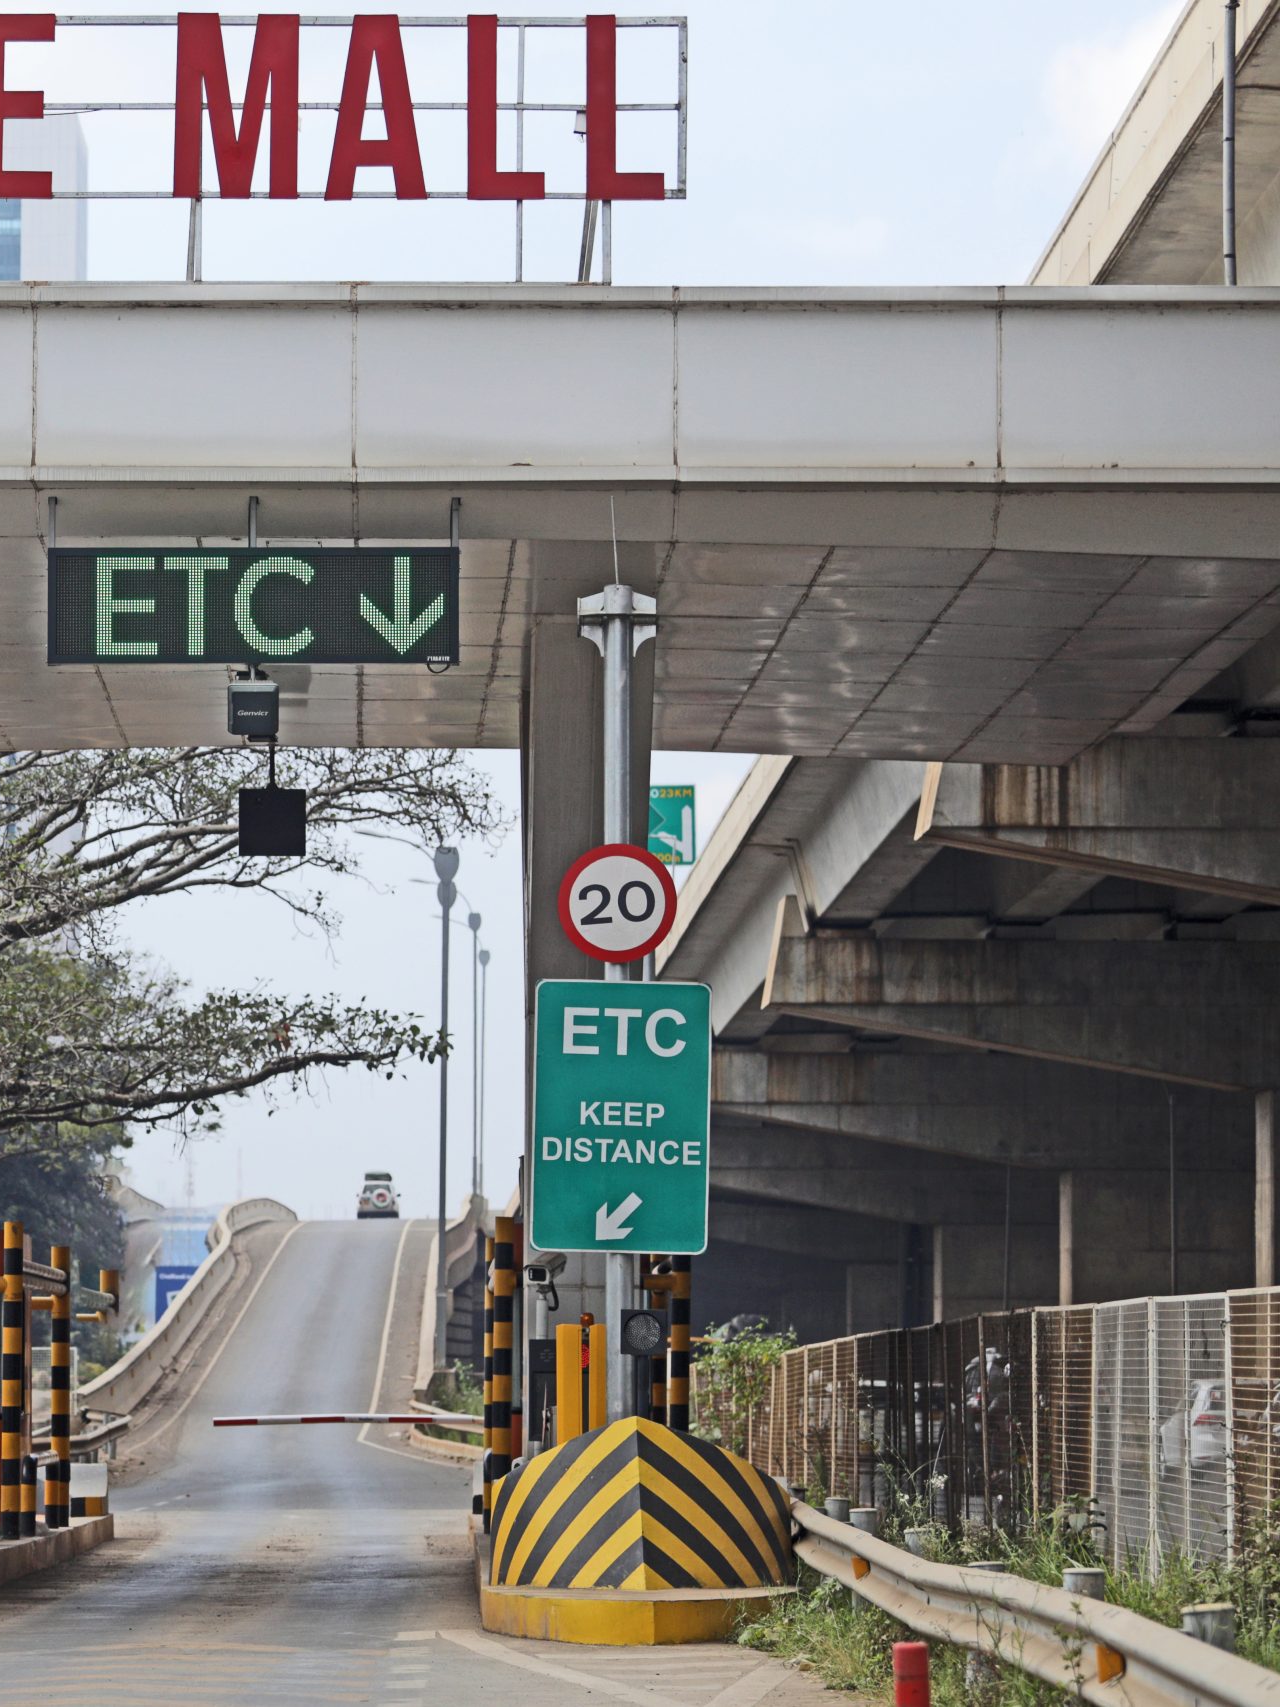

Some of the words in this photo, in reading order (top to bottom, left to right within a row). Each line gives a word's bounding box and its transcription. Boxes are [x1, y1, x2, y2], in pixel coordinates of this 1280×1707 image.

[172, 12, 665, 200] MALL
[96, 556, 315, 656] ETC
[578, 880, 656, 926] 20
[562, 1006, 687, 1058] ETC
[579, 1100, 665, 1128] KEEP
[541, 1136, 702, 1166] DISTANCE
